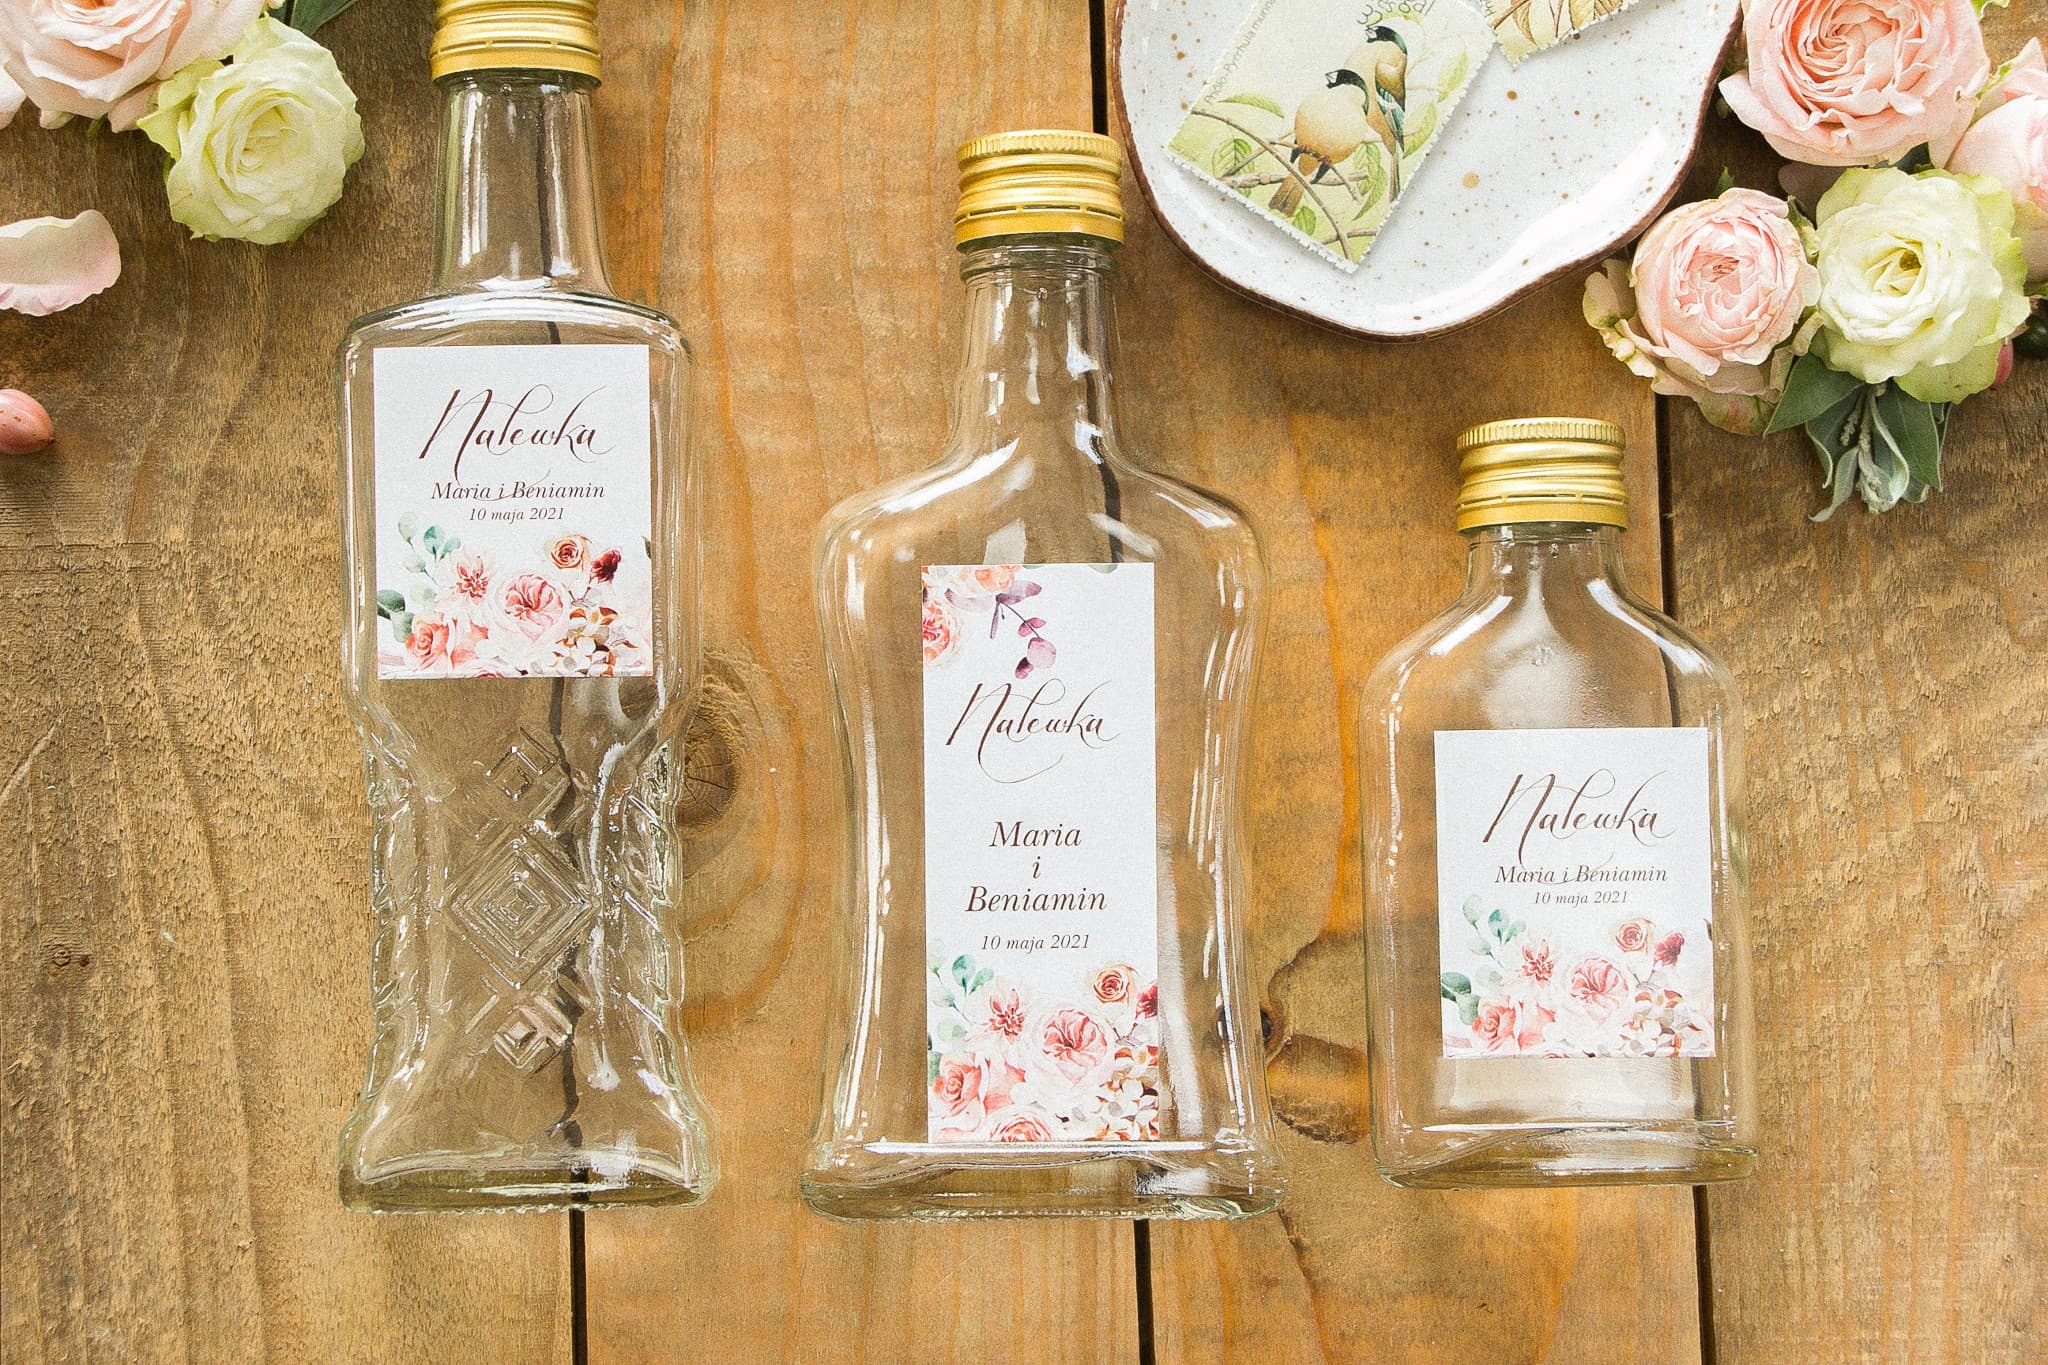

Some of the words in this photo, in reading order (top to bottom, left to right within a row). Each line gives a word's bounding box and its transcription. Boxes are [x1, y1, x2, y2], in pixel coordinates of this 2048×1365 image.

[418, 383, 617, 501] Nalewka
[431, 481, 491, 500] Maria
[498, 481, 505, 499] i
[511, 480, 605, 499] Beniamin
[468, 507, 487, 521] 10
[490, 508, 525, 525] maja
[528, 507, 565, 521] 2021
[945, 678, 1120, 783] Nalewka
[989, 820, 1082, 848] Maria
[1482, 768, 1677, 884] Nalewka
[1031, 855, 1042, 879] i
[1494, 865, 1555, 884] Maria
[1562, 866, 1569, 883] i
[1575, 864, 1668, 883] Beniamin
[964, 885, 1107, 912] Beniamin
[1533, 891, 1551, 905] 10
[1555, 892, 1589, 908] maja
[1593, 890, 1629, 904] 2021
[980, 934, 1001, 950] 10
[1006, 935, 1044, 954] maja
[1049, 933, 1090, 949] 2021
